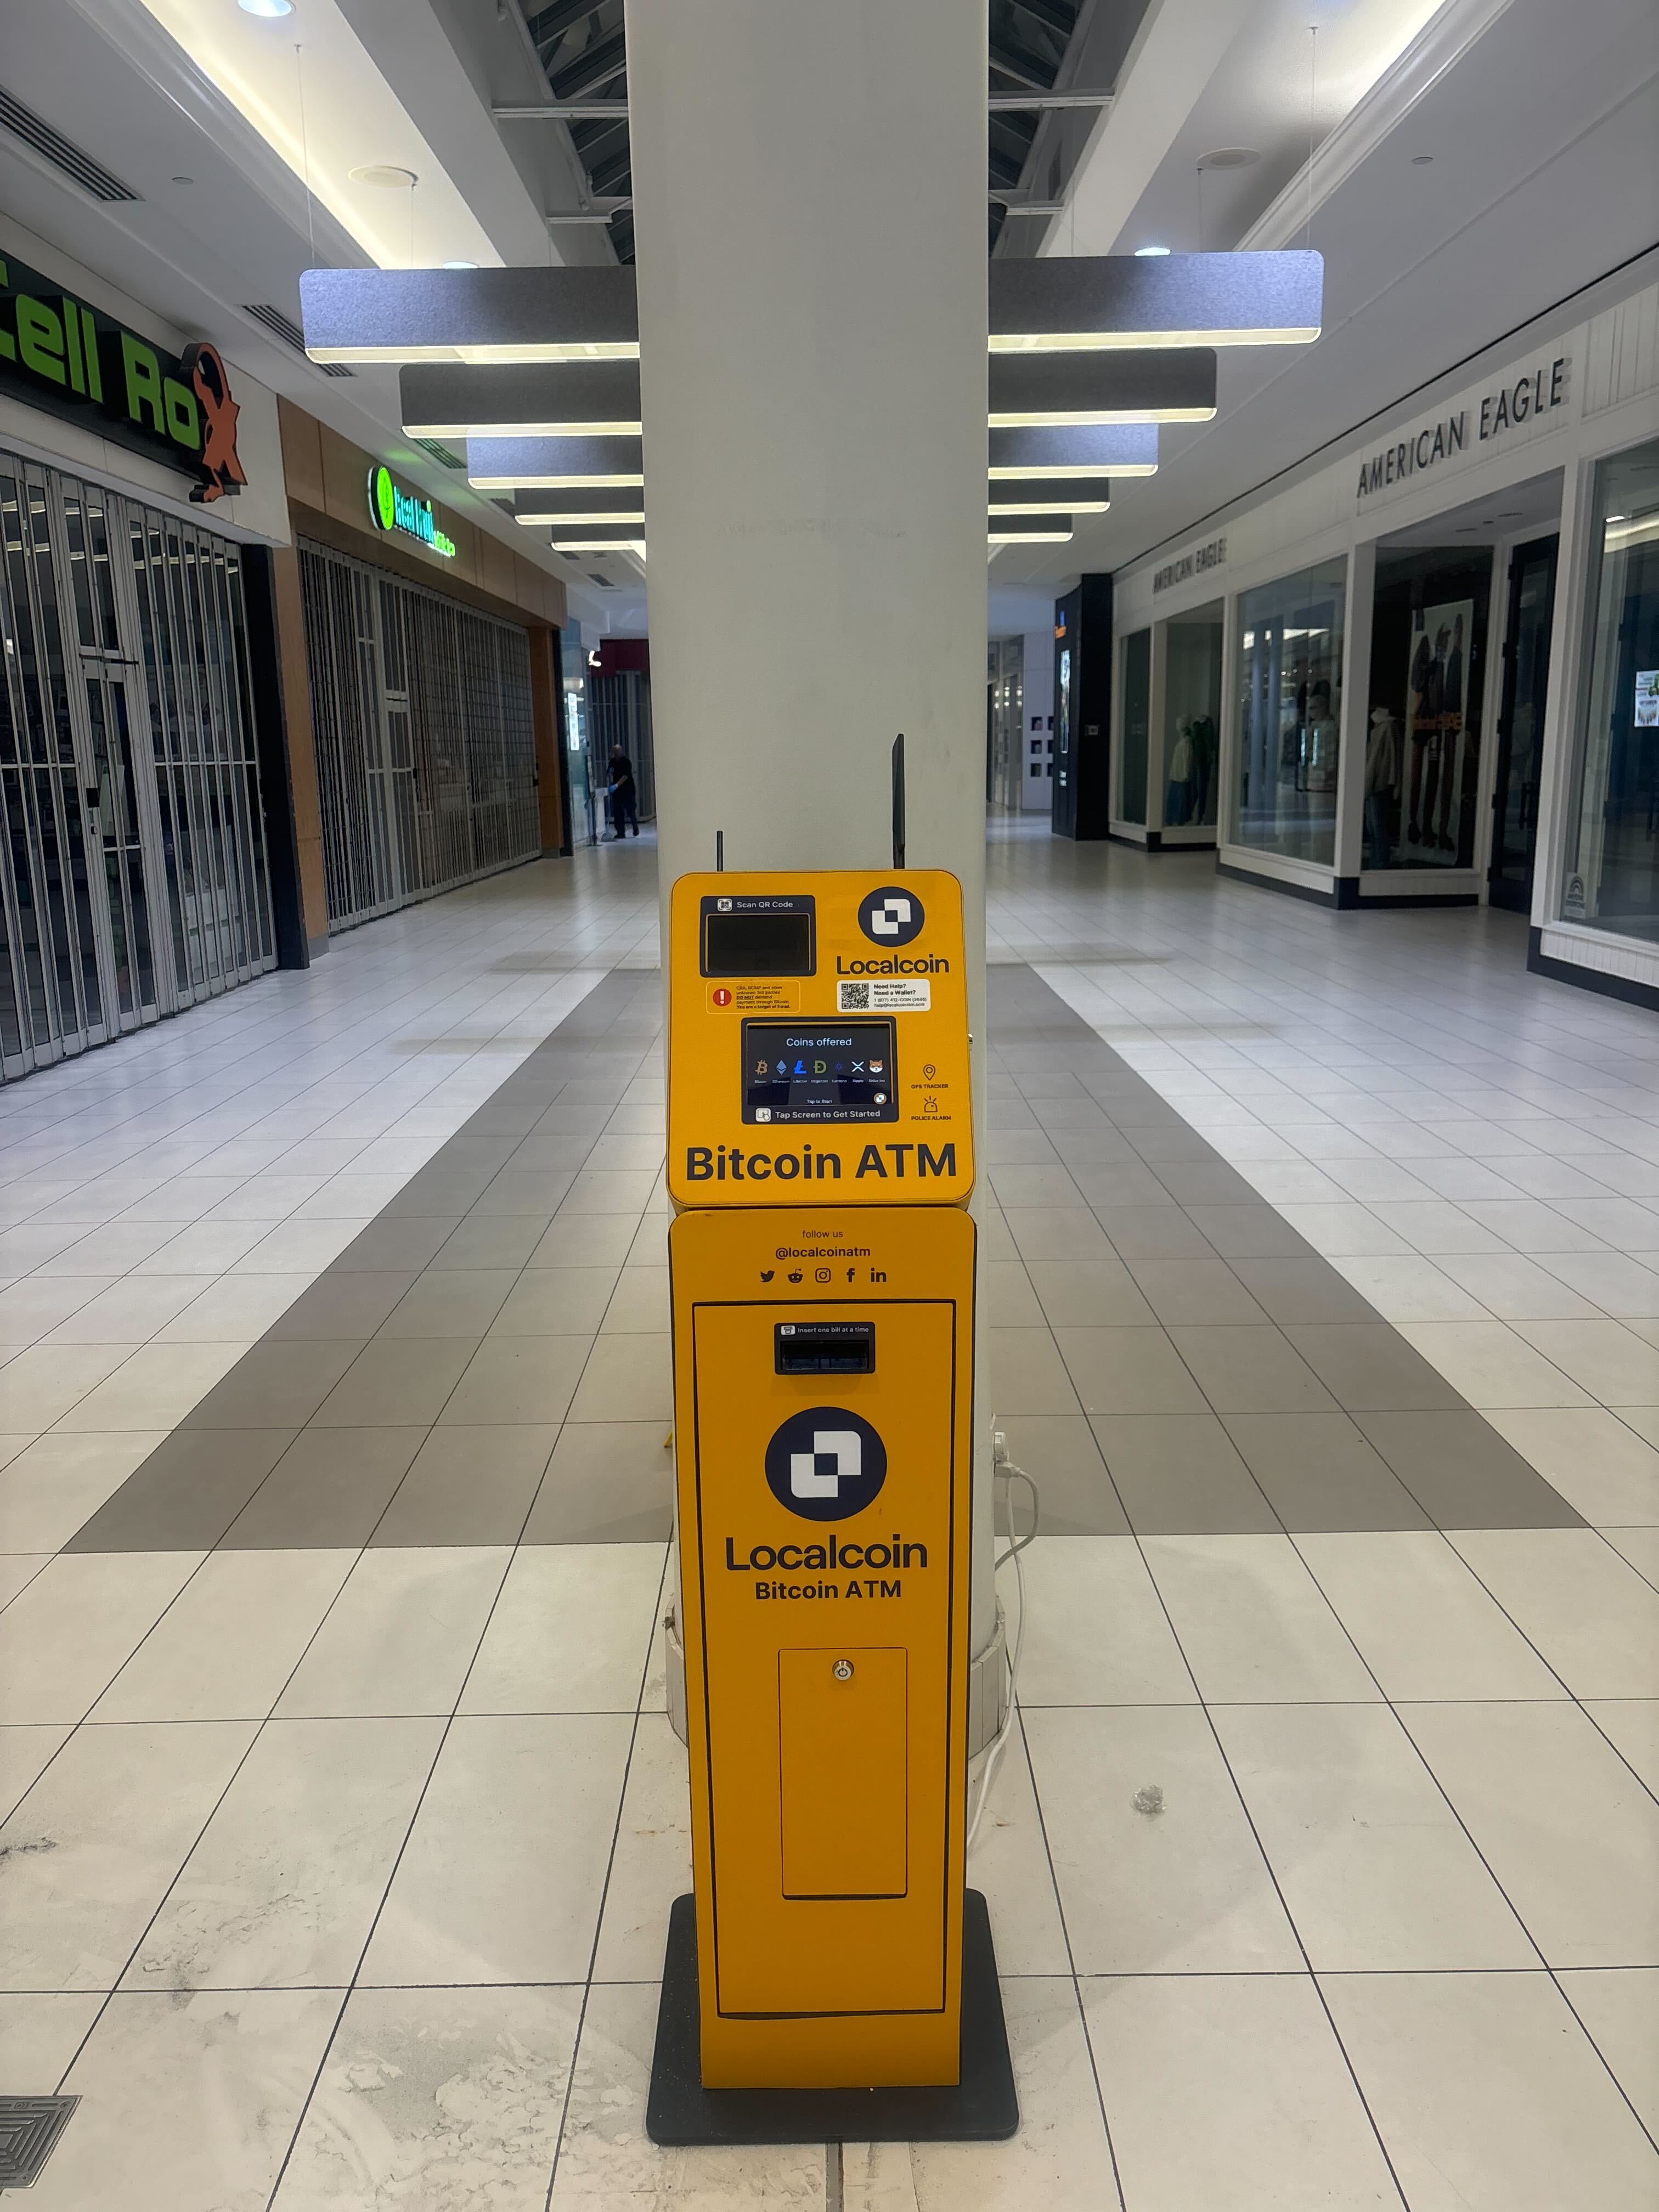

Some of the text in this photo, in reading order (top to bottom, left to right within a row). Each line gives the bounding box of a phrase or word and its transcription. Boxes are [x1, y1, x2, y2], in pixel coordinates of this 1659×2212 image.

[1357, 358, 1565, 499] AMERICAN EAGLE
[1153, 538, 1224, 594] AMERICAN EAGLE
[836, 953, 950, 975] Localcoin
[786, 1037, 852, 1047] Coins offered
[775, 1111, 791, 1120] Tap
[686, 1143, 956, 1181] Bitcoin ATM
[802, 1229, 830, 1238] follow
[775, 1246, 871, 1260] @localcoinatm
[725, 1533, 928, 1571] Localcoin
[755, 1579, 901, 1600] Bitcoin ATM
